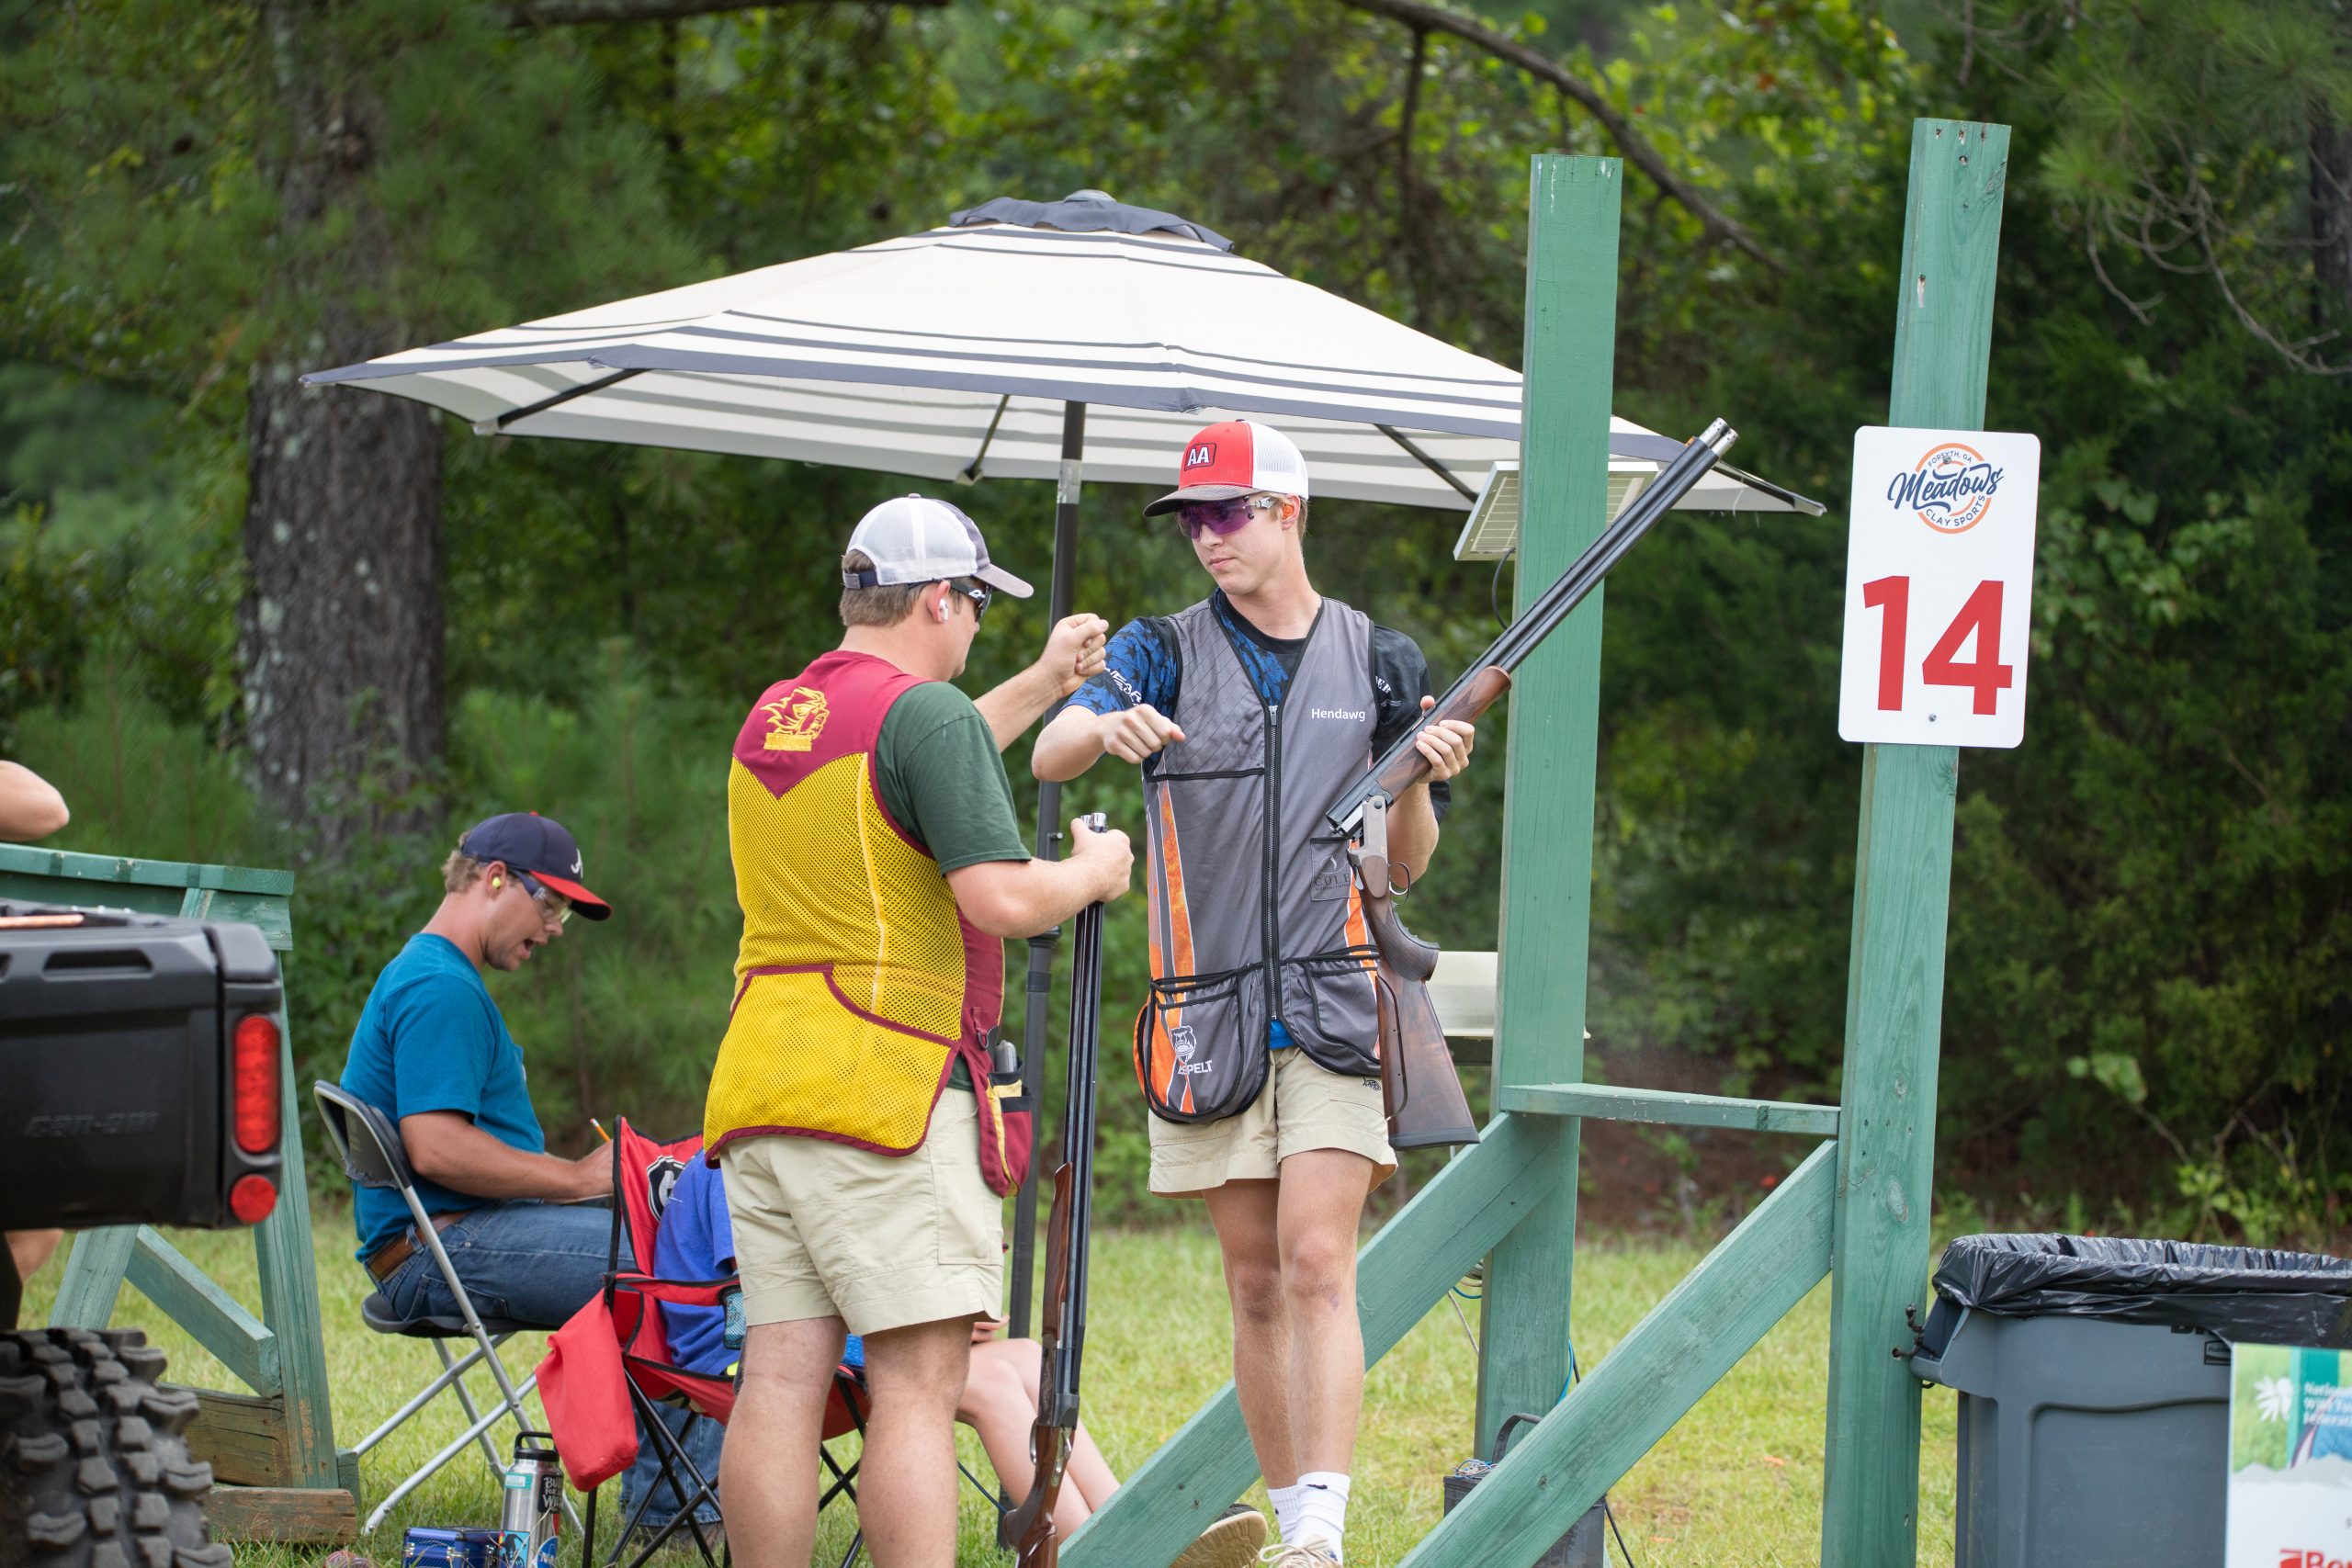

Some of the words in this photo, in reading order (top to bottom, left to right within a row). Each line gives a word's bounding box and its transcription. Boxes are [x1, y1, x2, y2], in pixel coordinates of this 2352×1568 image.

[1186, 446, 1210, 467] AA
[1962, 453, 1973, 463] GA
[1887, 463, 2005, 513] Meadows
[1926, 508, 1951, 526] CLAY
[1953, 495, 1985, 526] SPORTS
[1862, 575, 2013, 716] 14
[1311, 708, 1366, 722] Hendawg
